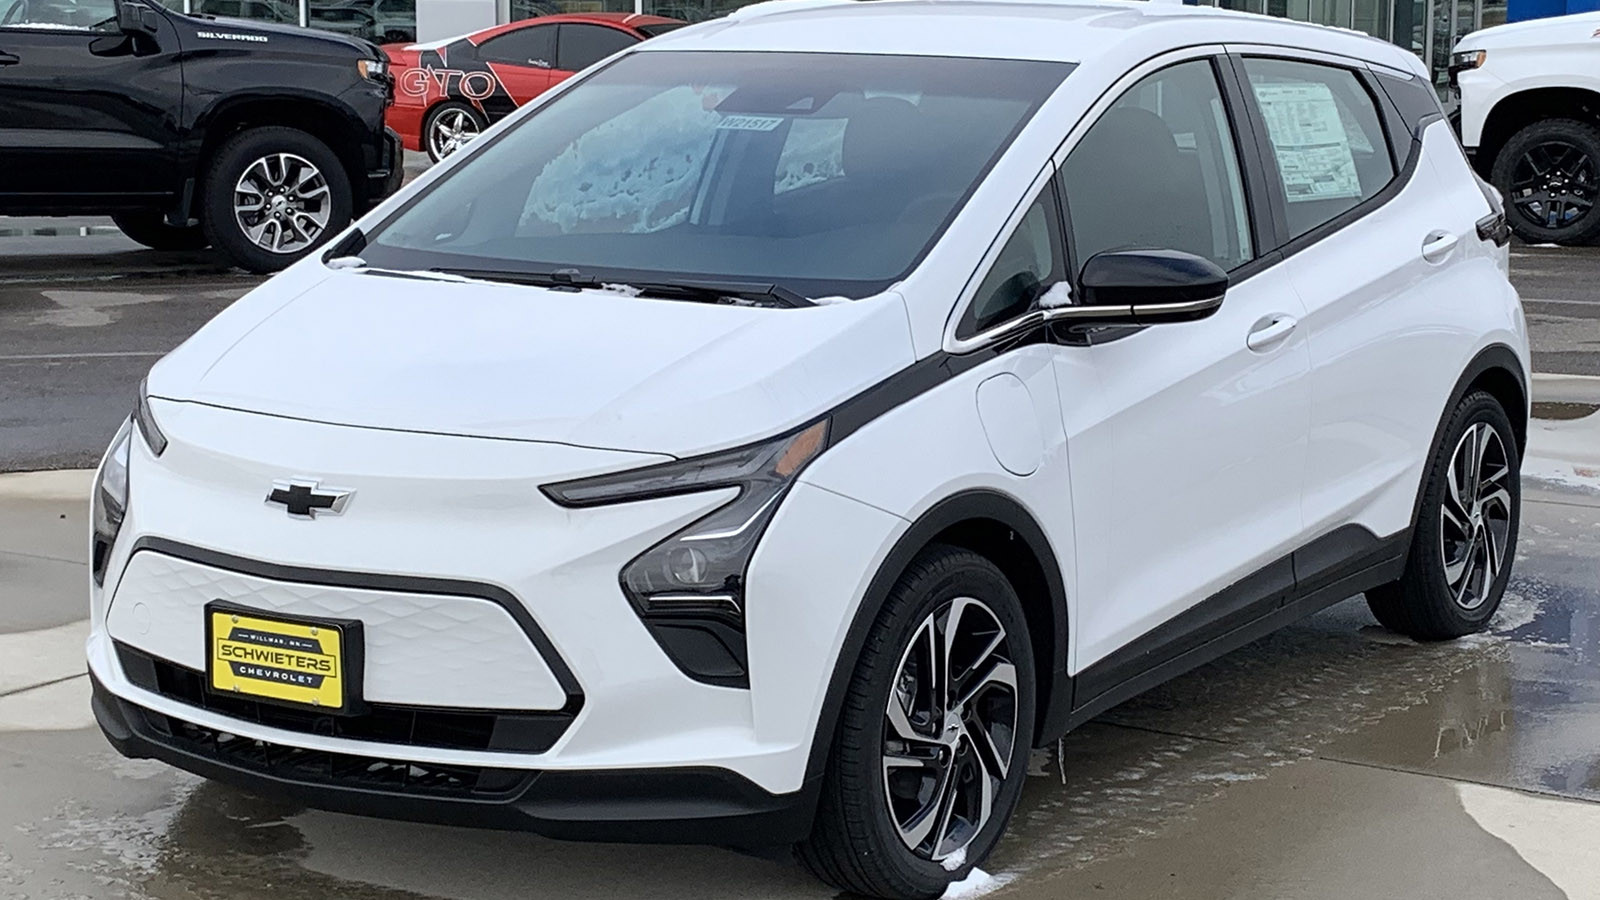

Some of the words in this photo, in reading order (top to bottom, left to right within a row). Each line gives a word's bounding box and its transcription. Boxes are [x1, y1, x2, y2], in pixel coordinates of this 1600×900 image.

[197, 31, 268, 42] SILVERADO
[400, 67, 496, 100] GTO
[221, 644, 331, 671] SCHWIETERS
[239, 666, 313, 684] CHEVROLET
